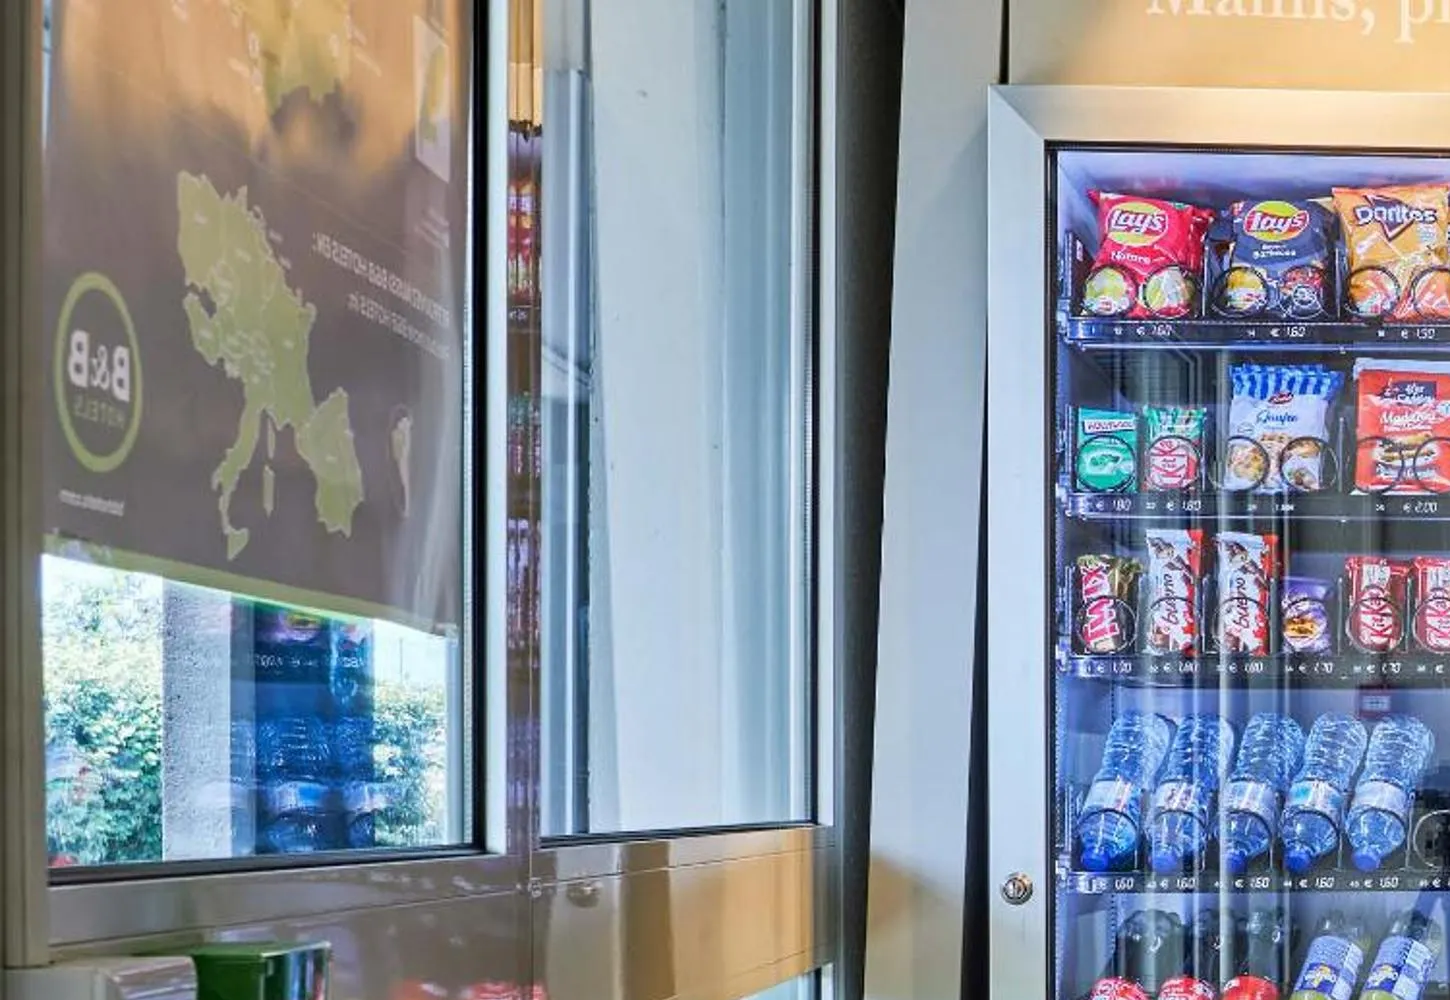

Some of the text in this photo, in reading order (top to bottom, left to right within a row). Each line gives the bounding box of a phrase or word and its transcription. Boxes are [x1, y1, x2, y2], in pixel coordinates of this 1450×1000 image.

[1110, 209, 1167, 233] Lay's
[1252, 211, 1306, 232] Lay's
[1355, 204, 1437, 226] Doritos
[1082, 561, 1121, 644] TWIX
